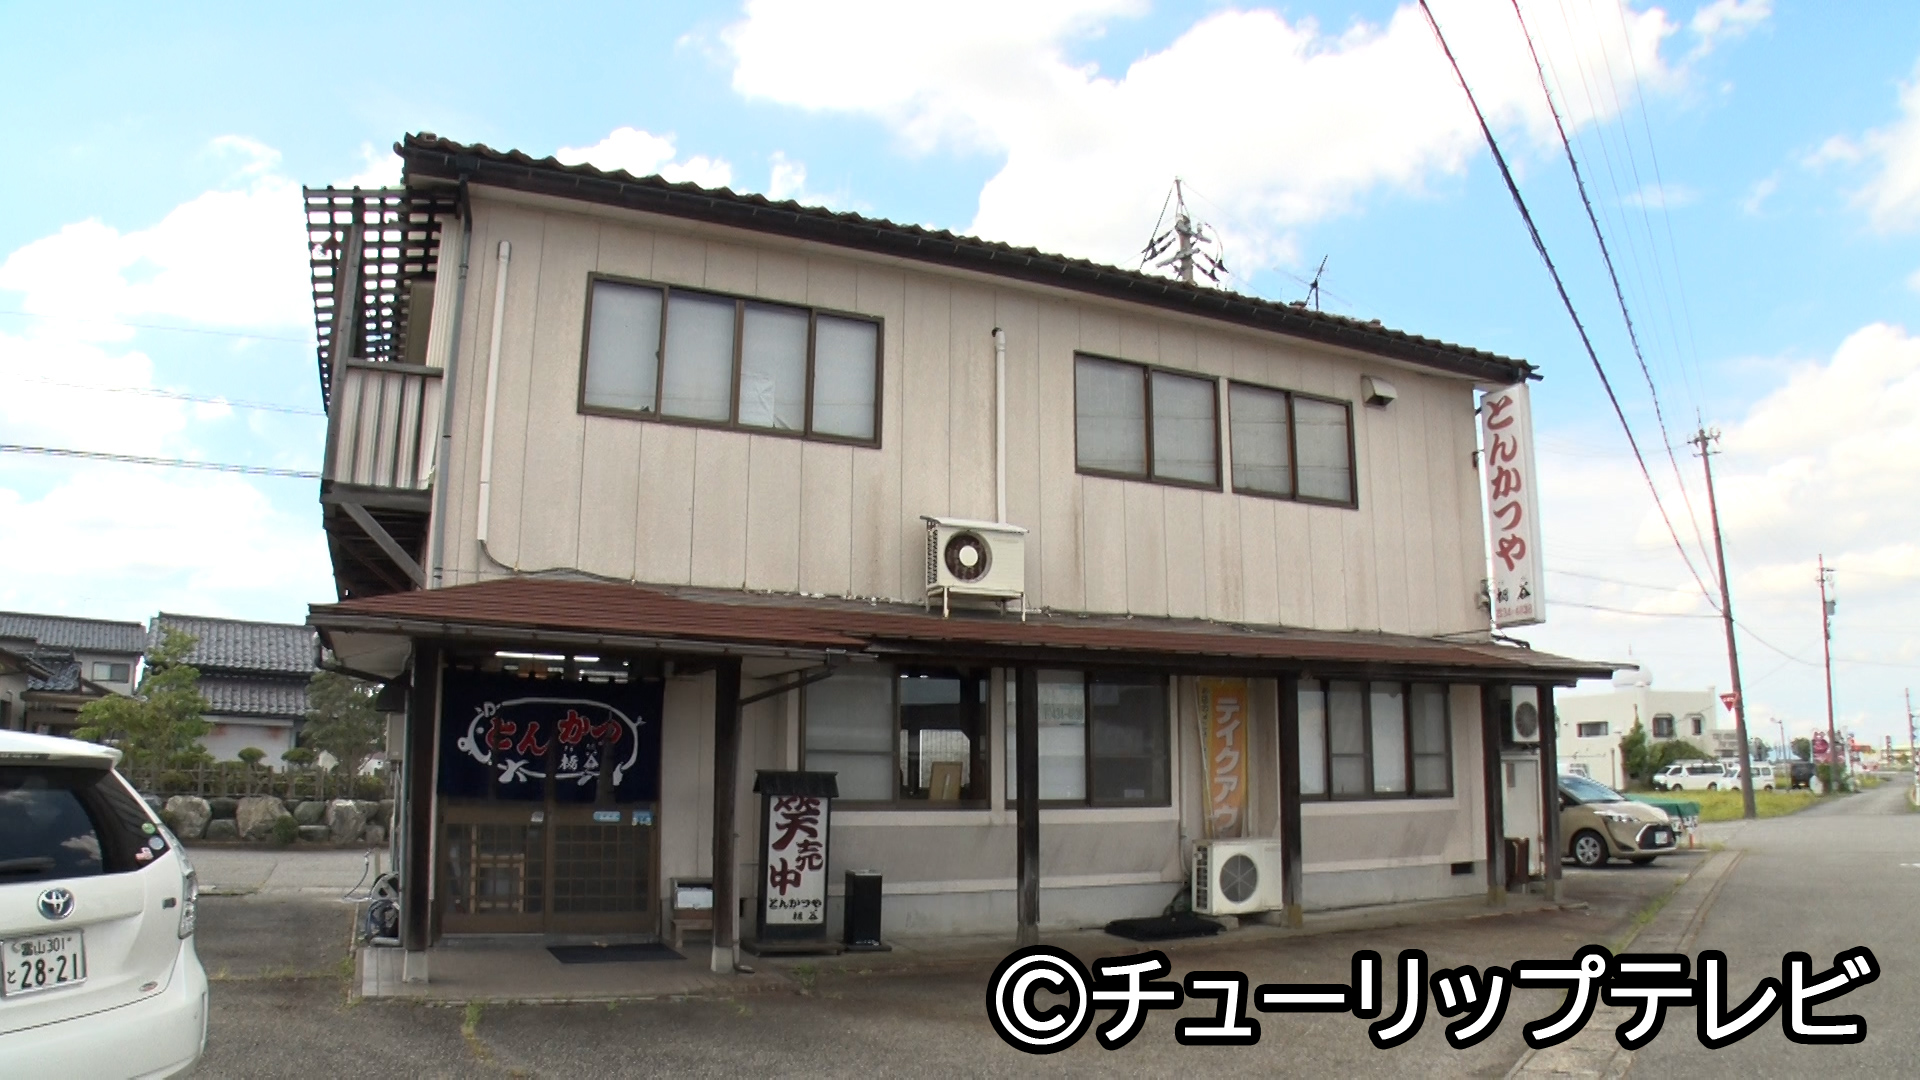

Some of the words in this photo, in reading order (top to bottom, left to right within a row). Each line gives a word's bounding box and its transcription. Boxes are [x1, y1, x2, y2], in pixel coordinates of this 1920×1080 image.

[1486, 395, 1526, 572] とんかつや
[485, 709, 622, 756] とんかつ
[769, 899, 821, 909] とんかつや
[21, 953, 78, 989] 28-21
